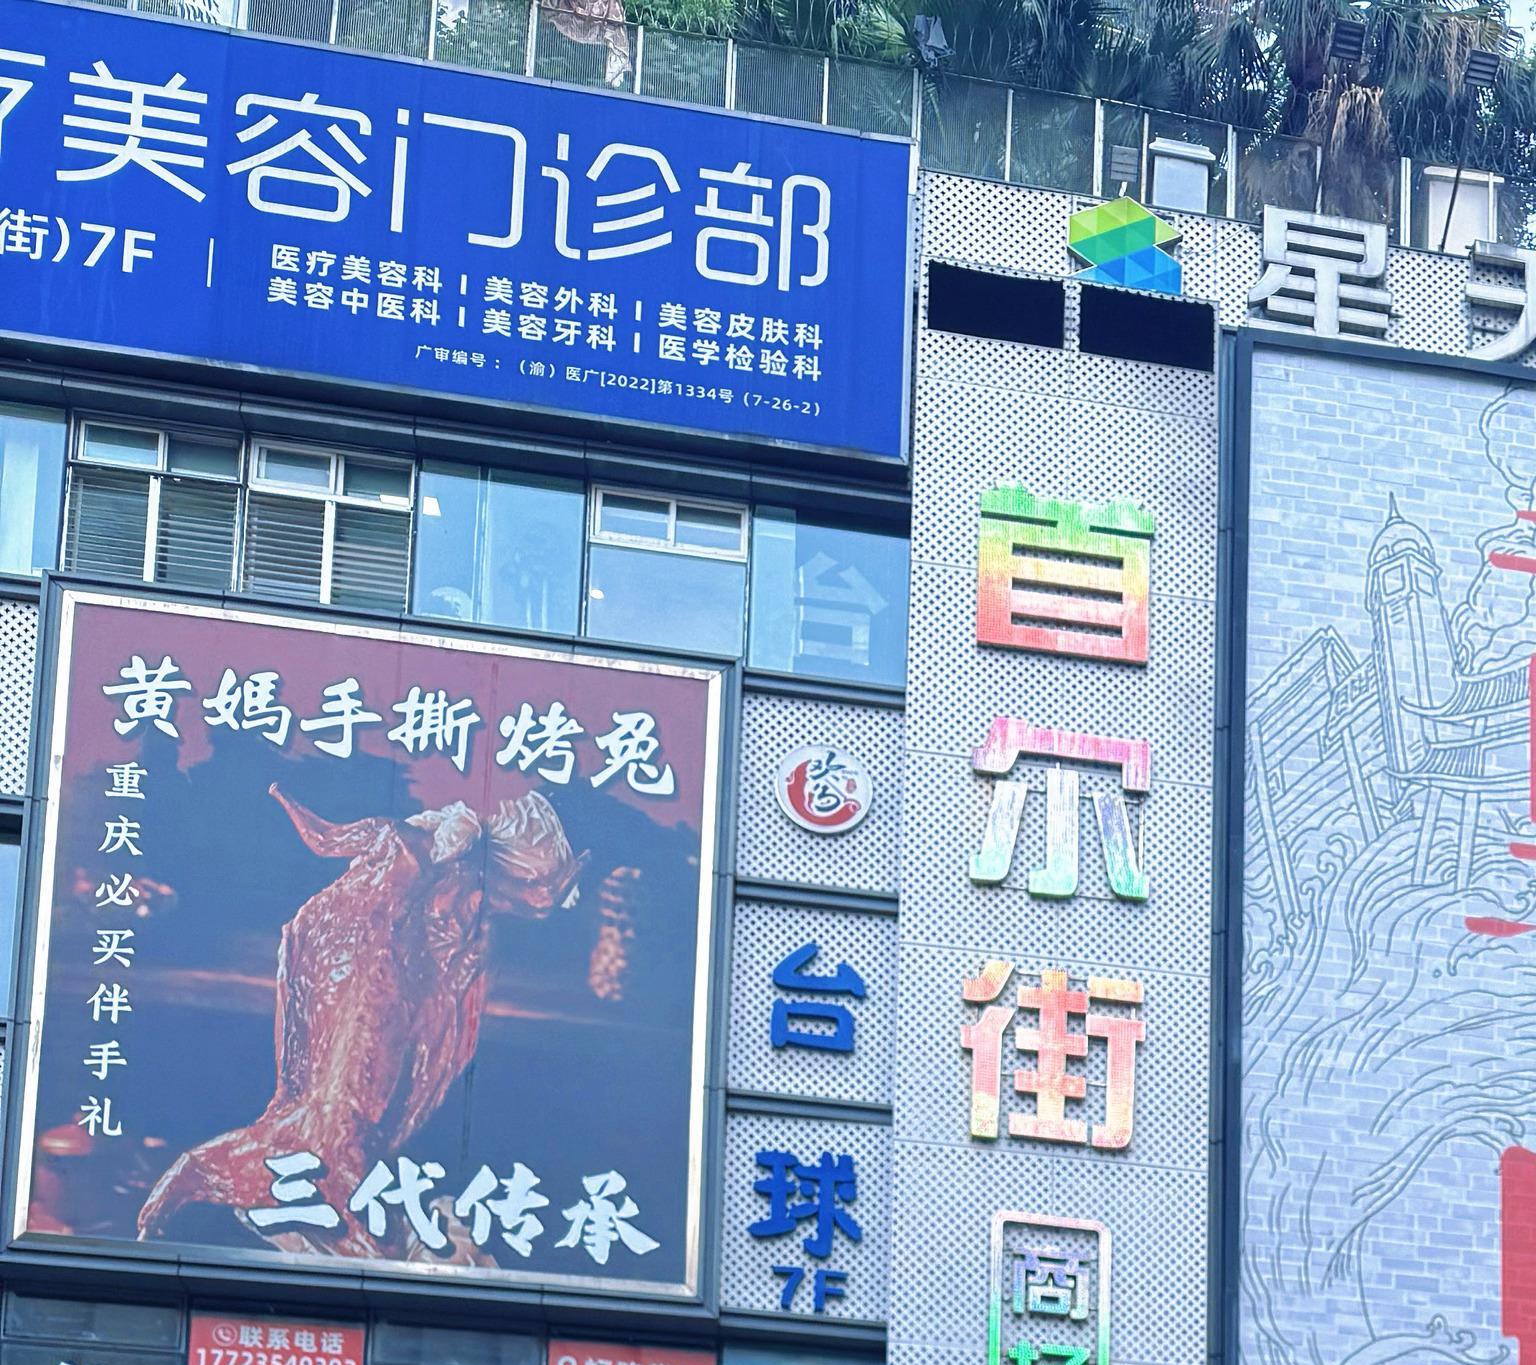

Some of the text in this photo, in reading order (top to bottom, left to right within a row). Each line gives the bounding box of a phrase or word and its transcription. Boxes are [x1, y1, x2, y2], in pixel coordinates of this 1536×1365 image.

[267, 277, 822, 381] 美容中医科 美容牙科 医学检验科
[271, 243, 823, 349] 医疗美容科 美容外科 美容皮肤科
[102, 654, 676, 796] 黄媽手撕烤兔
[78, 761, 151, 1139] 重庆必买伴手礼
[748, 941, 867, 1261] 台球
[249, 1151, 661, 1265] 三代传承
[239, 1324, 345, 1355] 联系电话
[771, 1266, 847, 1313] 7F
